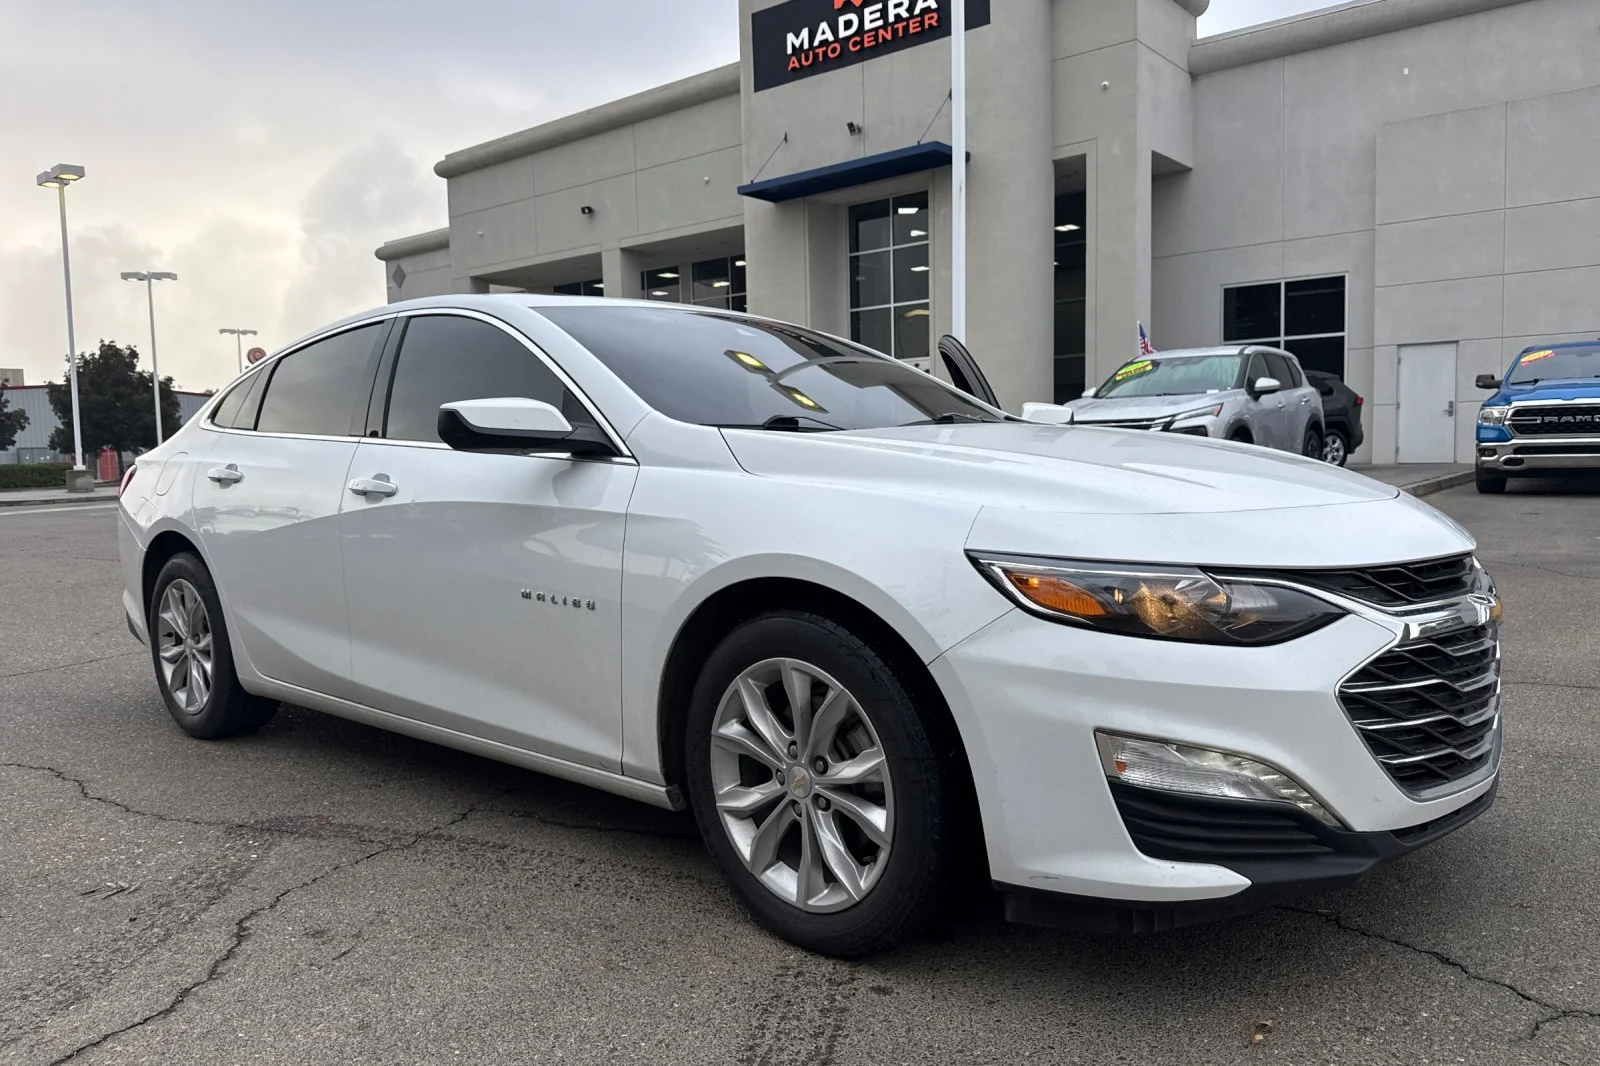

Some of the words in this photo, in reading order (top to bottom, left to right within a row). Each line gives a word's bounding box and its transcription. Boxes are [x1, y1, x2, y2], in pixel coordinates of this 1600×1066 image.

[786, 0, 939, 55] MADERA
[787, 44, 841, 71] AUTO
[848, 12, 939, 52] CENTER
[520, 588, 596, 611] MALIBU
